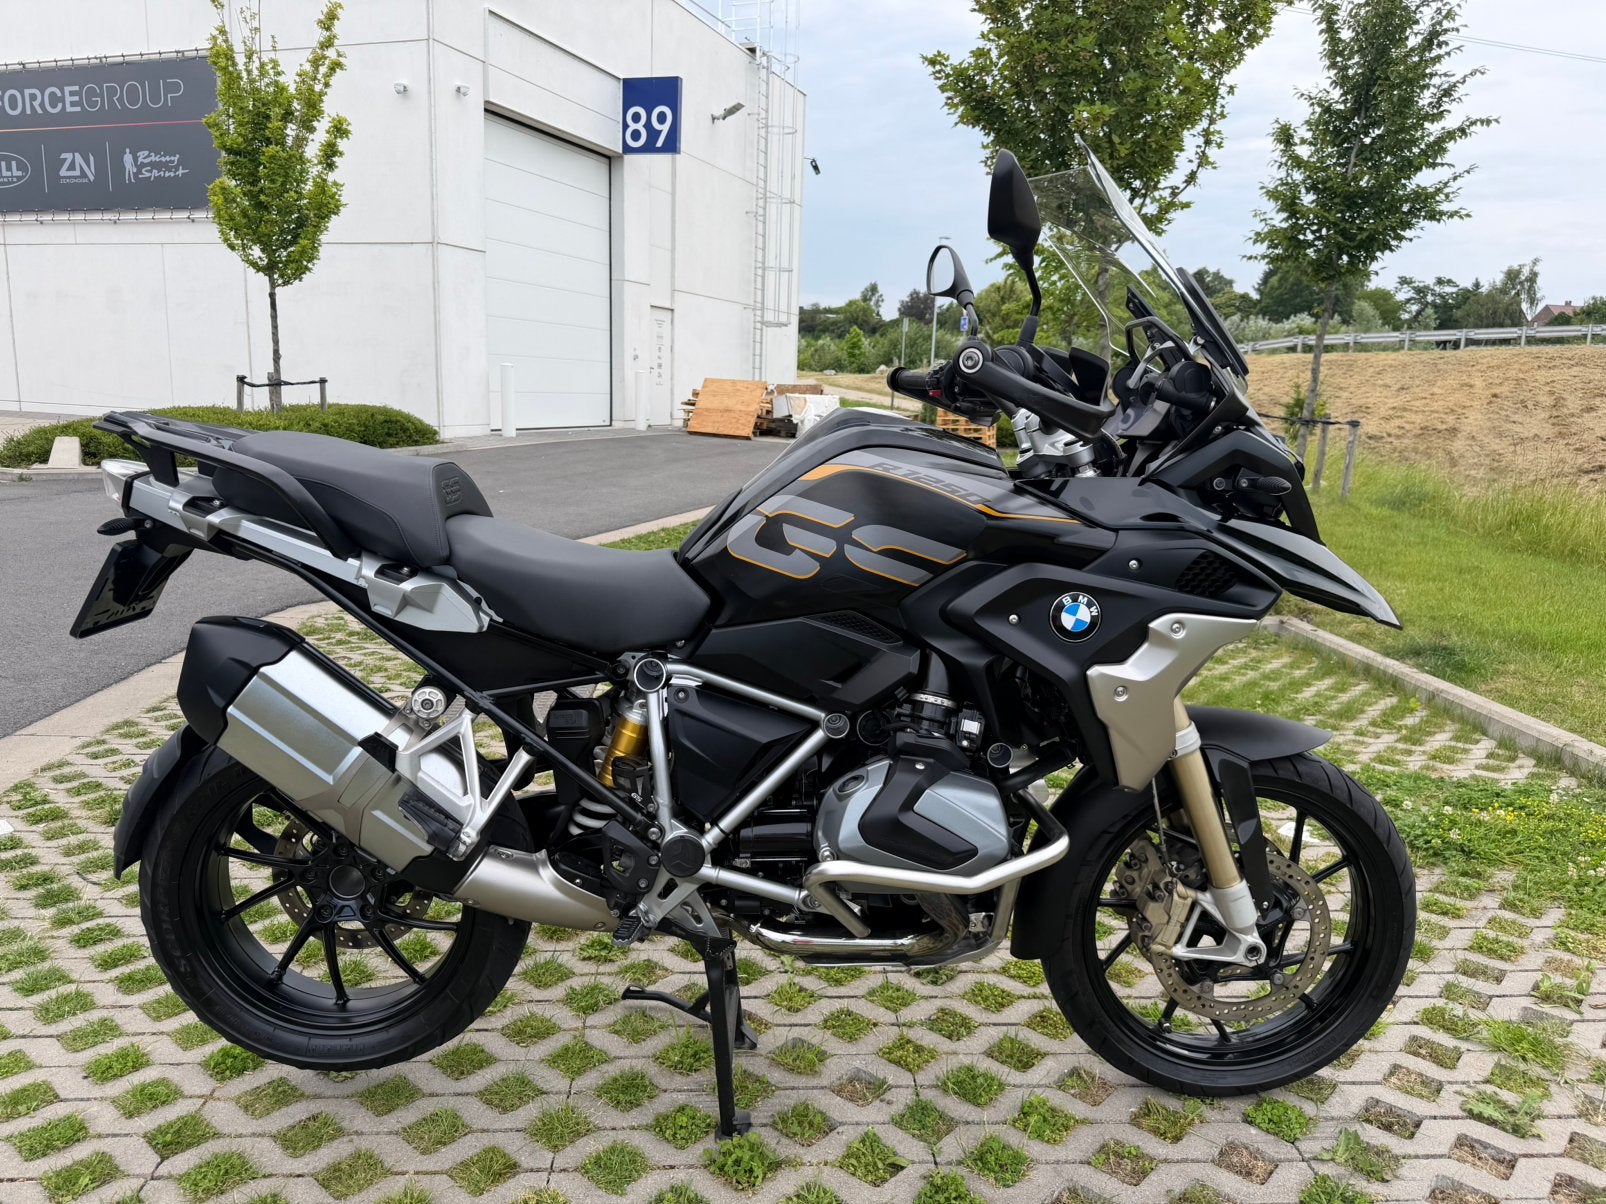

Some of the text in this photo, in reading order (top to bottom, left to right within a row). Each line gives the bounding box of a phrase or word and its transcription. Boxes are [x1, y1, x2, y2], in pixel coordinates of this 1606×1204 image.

[0, 79, 184, 116] ORCEGROUP
[625, 105, 673, 148] 89
[0, 160, 22, 177] LL
[59, 152, 95, 182] ZN
[137, 150, 180, 166] Racing
[138, 165, 190, 181] Spirit
[726, 494, 967, 586] GS
[1062, 595, 1098, 616] BMW
